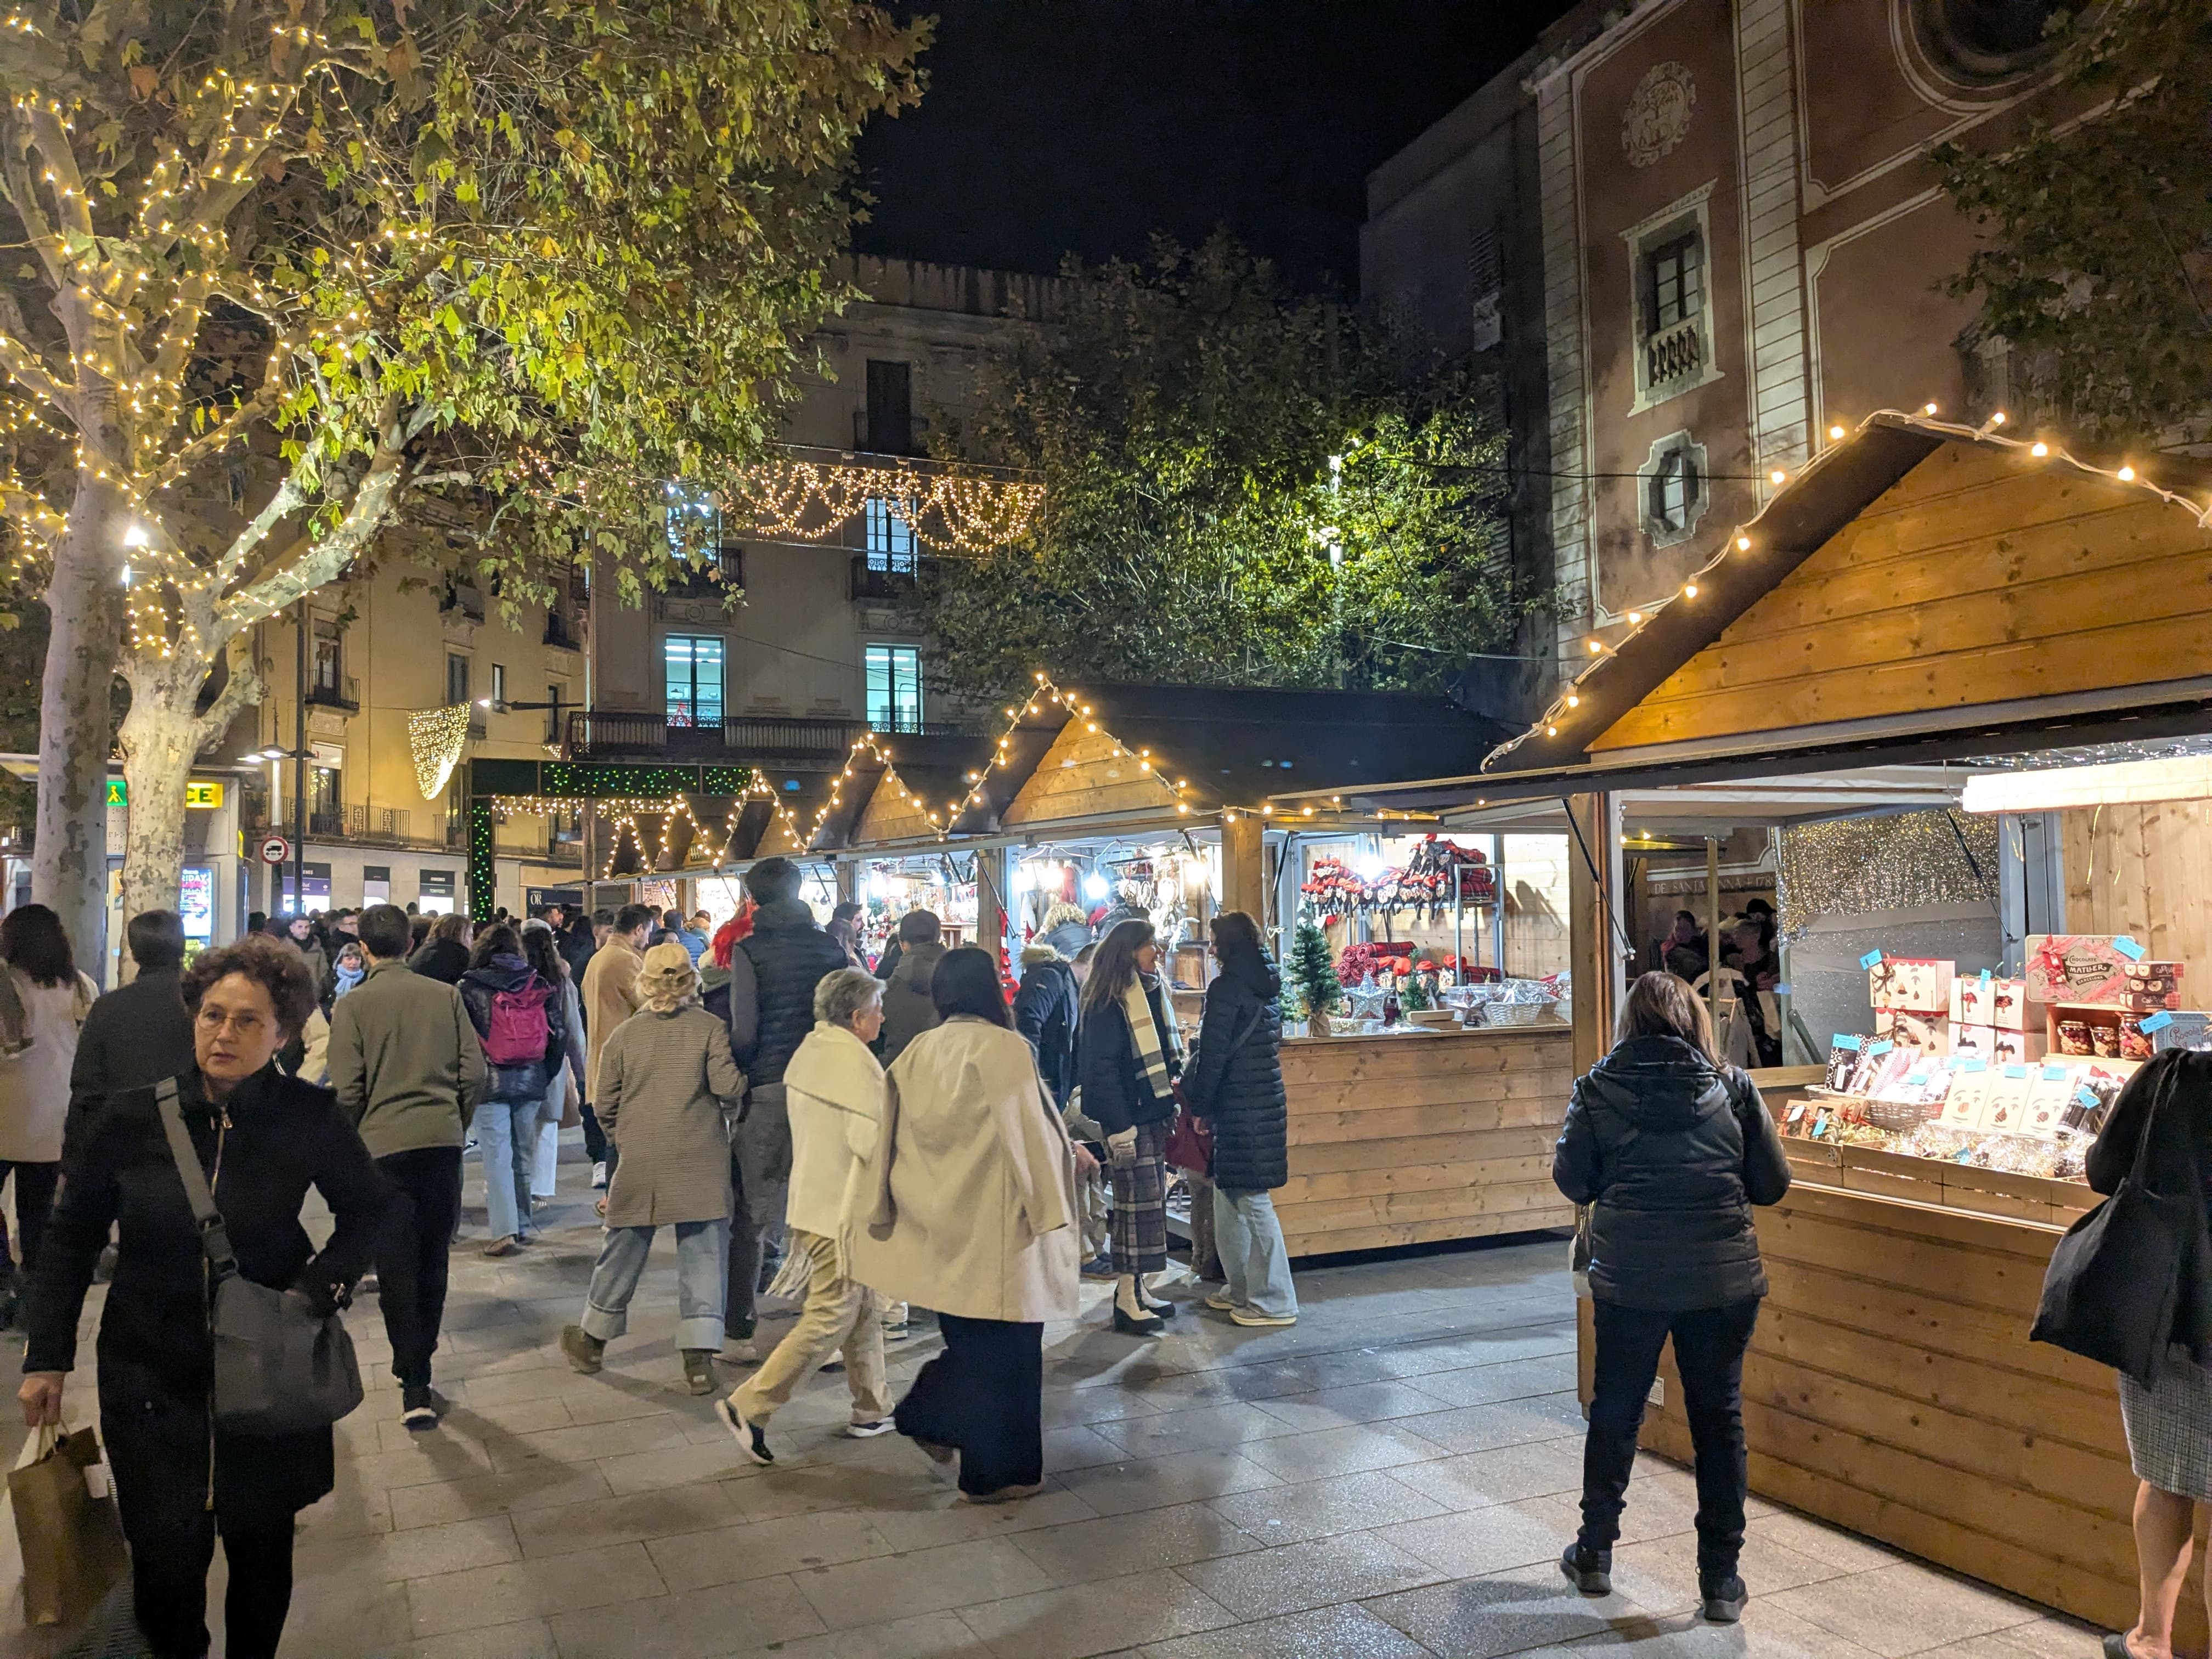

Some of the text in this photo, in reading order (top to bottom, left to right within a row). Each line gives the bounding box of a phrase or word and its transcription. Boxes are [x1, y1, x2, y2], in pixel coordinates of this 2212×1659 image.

[187, 788, 213, 803] CE
[182, 874, 207, 882] RIDAY
[1655, 883, 1667, 894] DE
[1673, 881, 1705, 893] SANTA
[1718, 878, 1742, 889] NNA
[530, 894, 542, 905] OR
[2069, 955, 2097, 964] CHOCOLATE
[2069, 964, 2107, 973] MATLLER
[2078, 976, 2103, 984] BARCELONA
